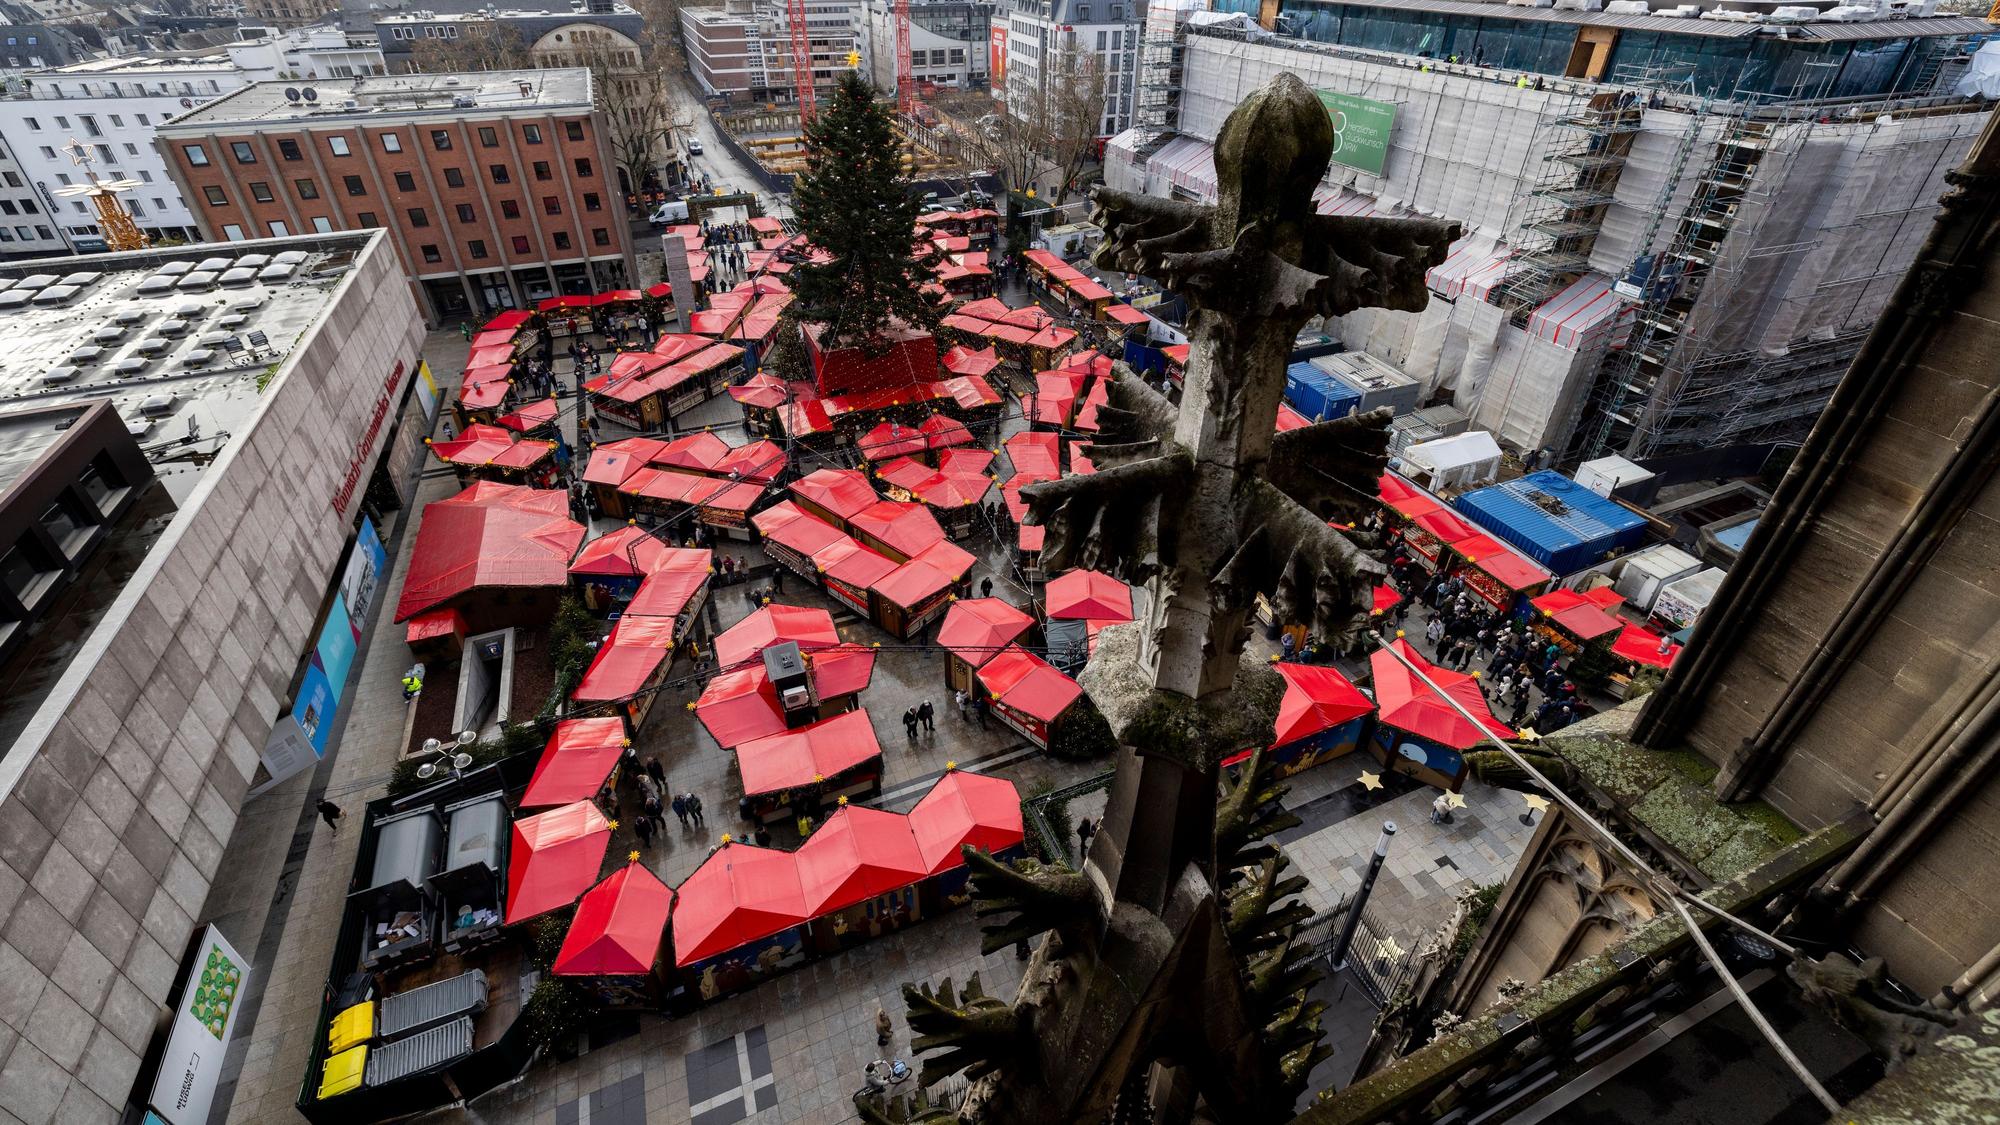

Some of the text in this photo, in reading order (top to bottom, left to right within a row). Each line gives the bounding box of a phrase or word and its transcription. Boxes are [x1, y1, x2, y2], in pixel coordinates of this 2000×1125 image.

[385, 359, 405, 400] Museum
[176, 1069, 191, 1110] MUSEUM
[182, 1073, 195, 1108] LUDWIG
